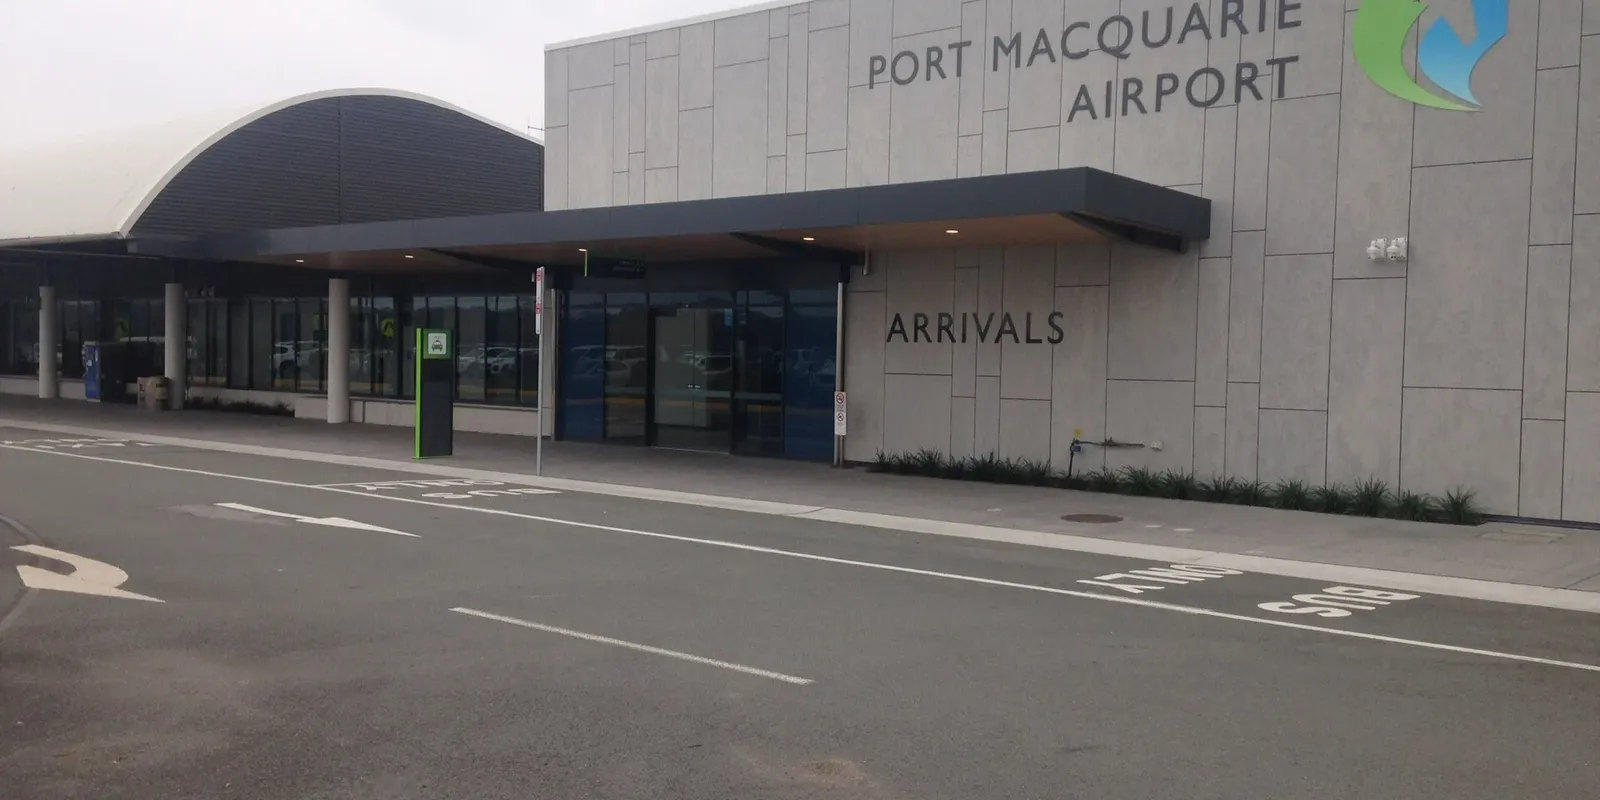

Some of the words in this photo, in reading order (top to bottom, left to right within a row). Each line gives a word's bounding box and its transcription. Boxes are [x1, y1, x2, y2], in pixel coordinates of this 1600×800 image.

[868, 40, 972, 90] PORT
[991, 0, 1302, 72] MACQUARIE
[1066, 55, 1299, 123] AIRPORT
[886, 311, 1065, 344] ARRIVALS
[421, 488, 562, 499] BUS
[1075, 564, 1244, 594] ONLY
[1257, 585, 1421, 618] BUS
